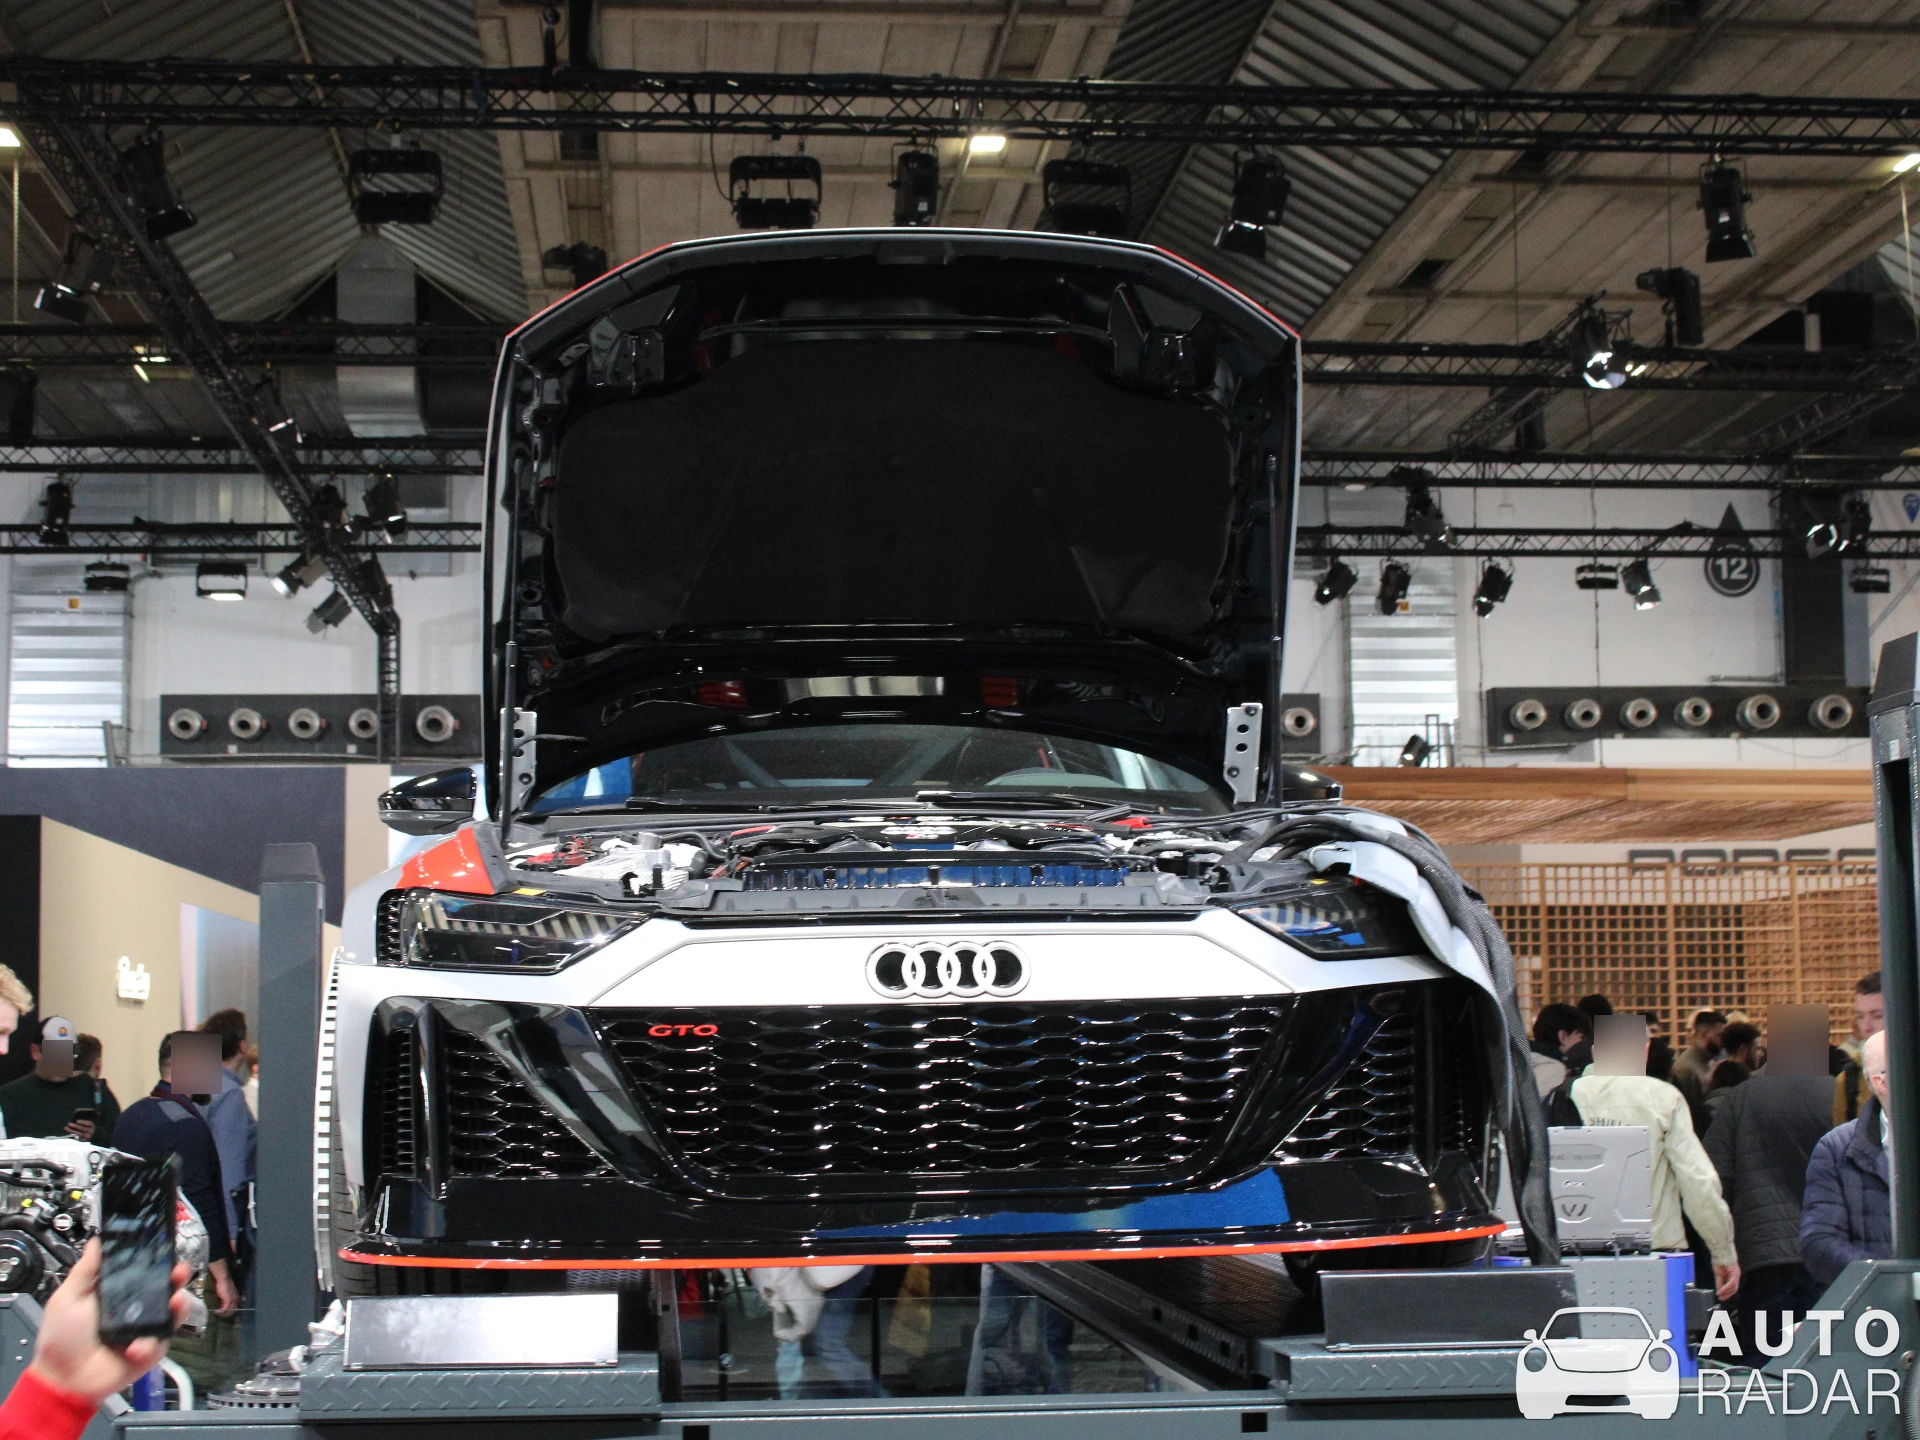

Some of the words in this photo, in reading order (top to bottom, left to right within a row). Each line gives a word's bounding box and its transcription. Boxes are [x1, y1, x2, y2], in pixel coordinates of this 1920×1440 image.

[1714, 557, 1748, 580] 12
[1629, 848, 1877, 876] PORSC
[648, 1024, 719, 1037] GTO
